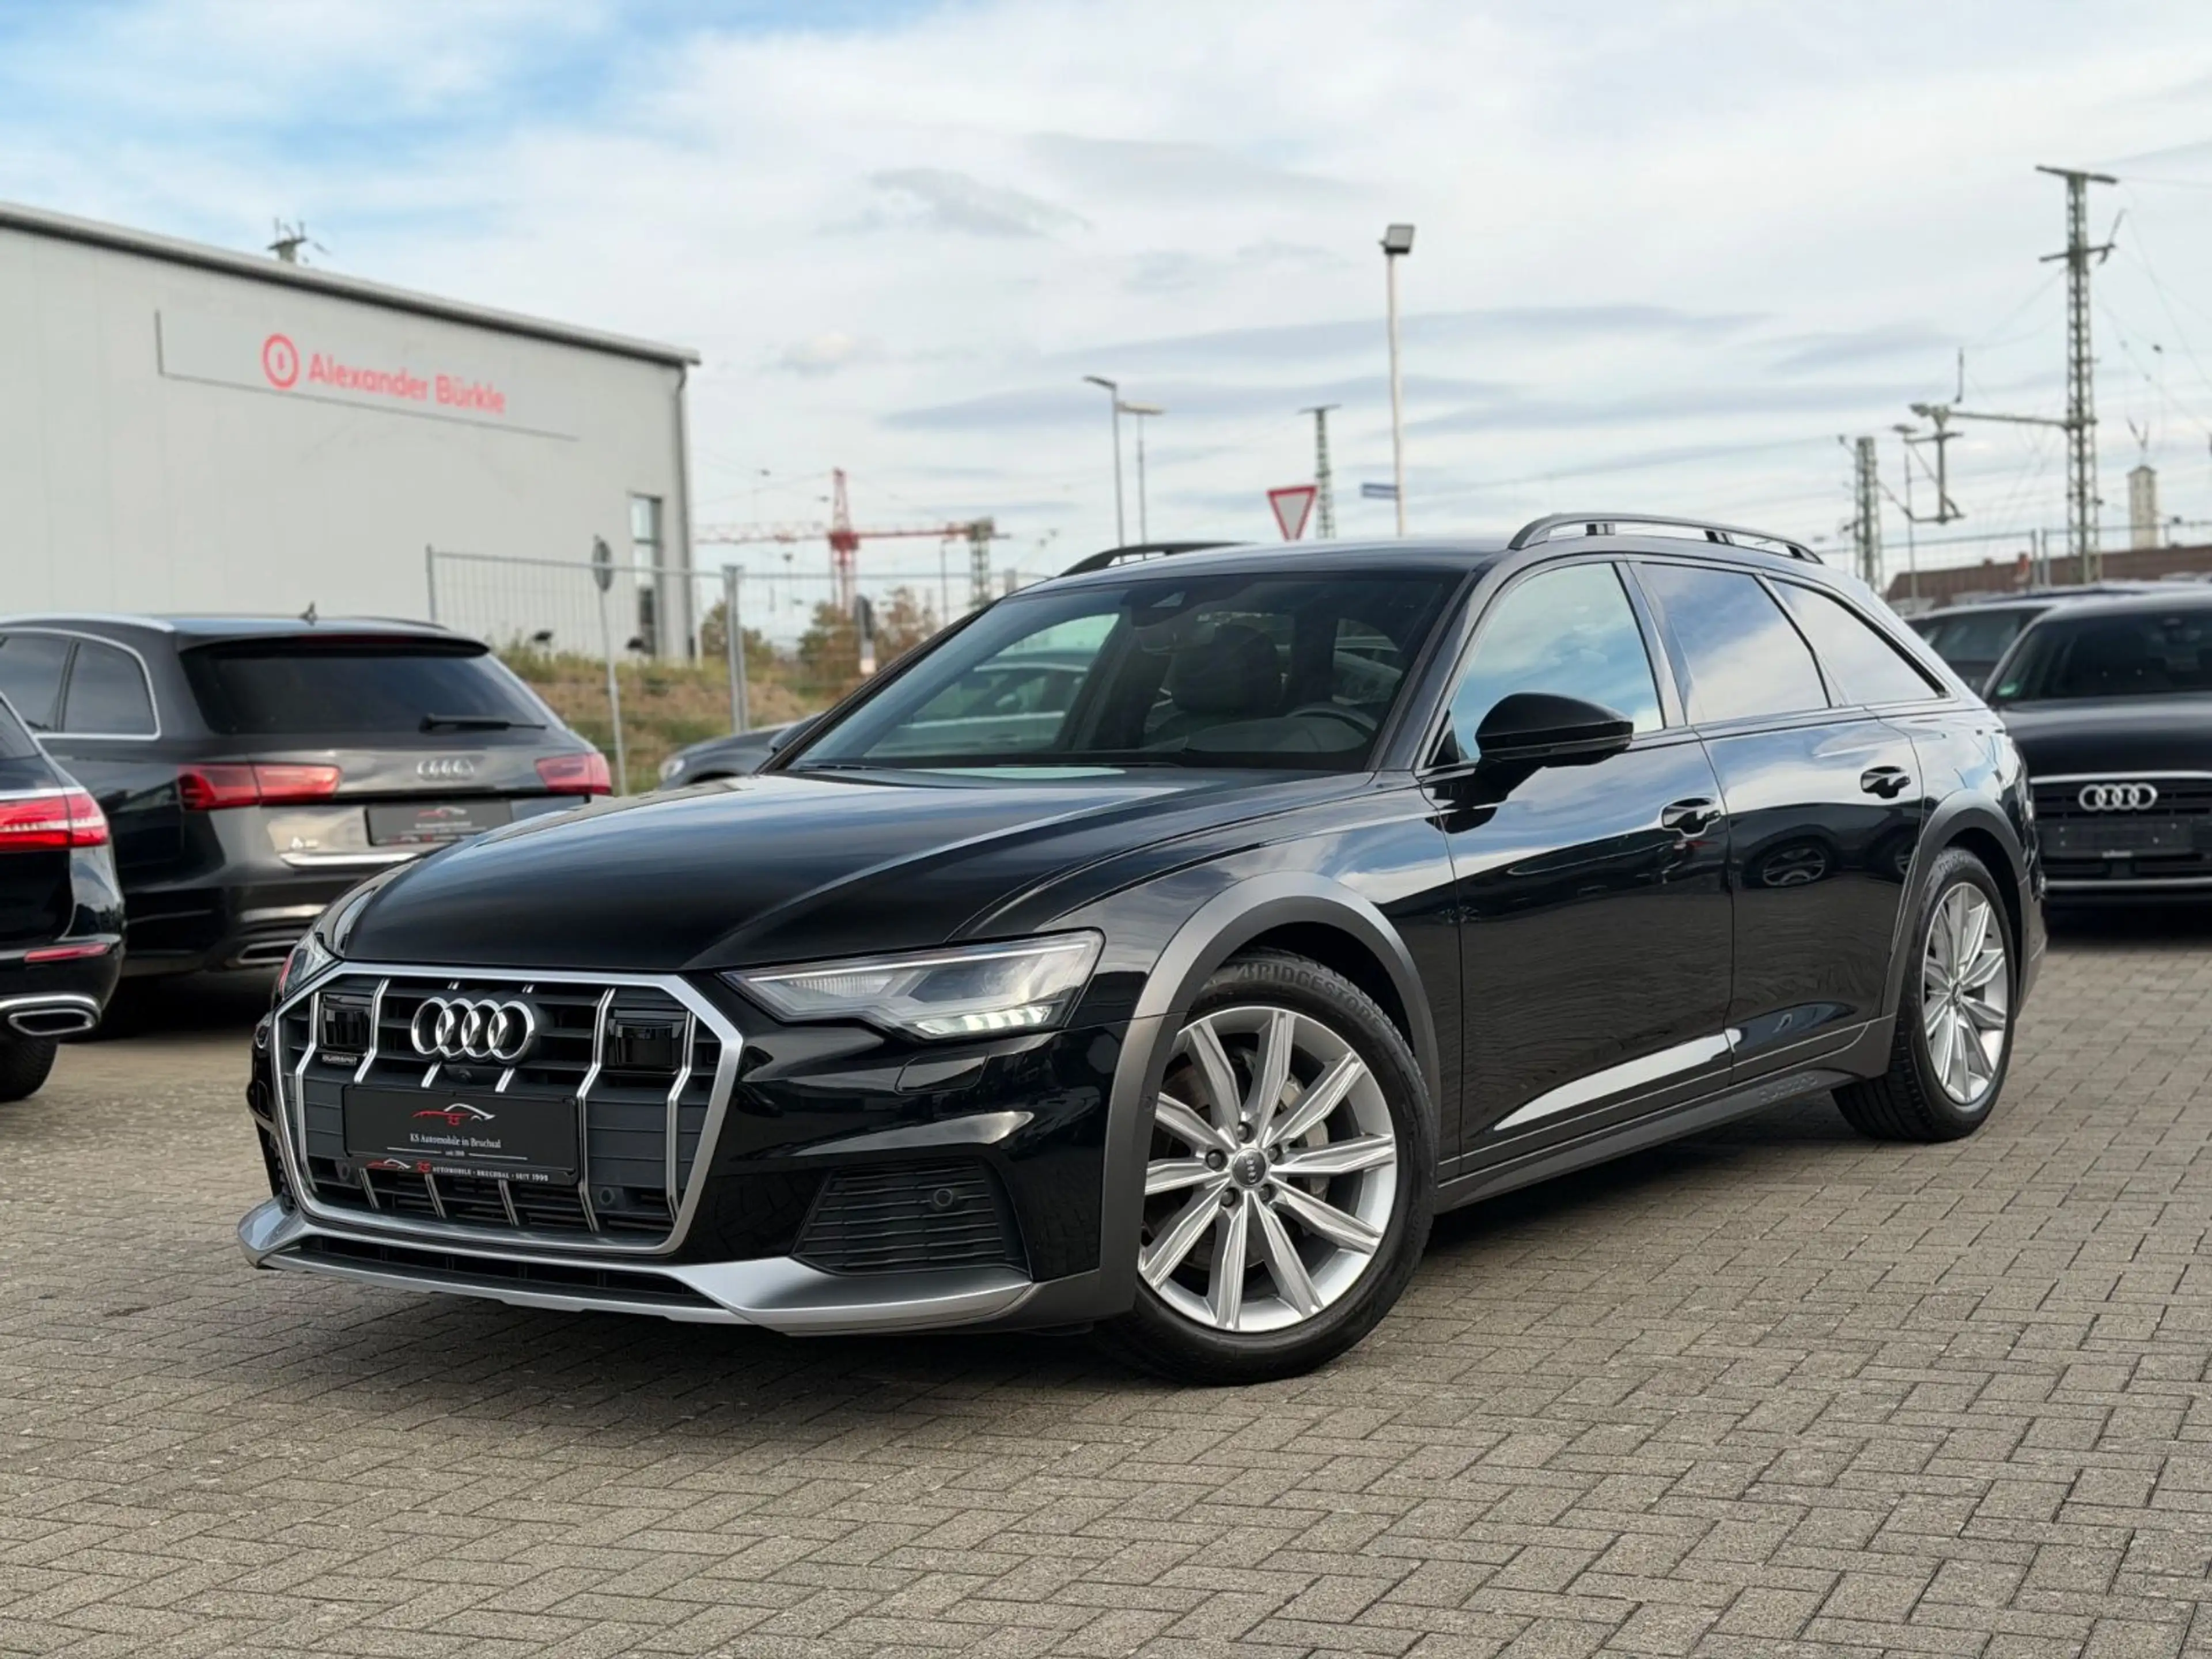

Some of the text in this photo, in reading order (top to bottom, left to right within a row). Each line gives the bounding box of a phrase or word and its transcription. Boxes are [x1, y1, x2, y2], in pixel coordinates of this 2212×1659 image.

[308, 353, 506, 414] Alexander Bürkle
[421, 1134, 461, 1147] Automobile
